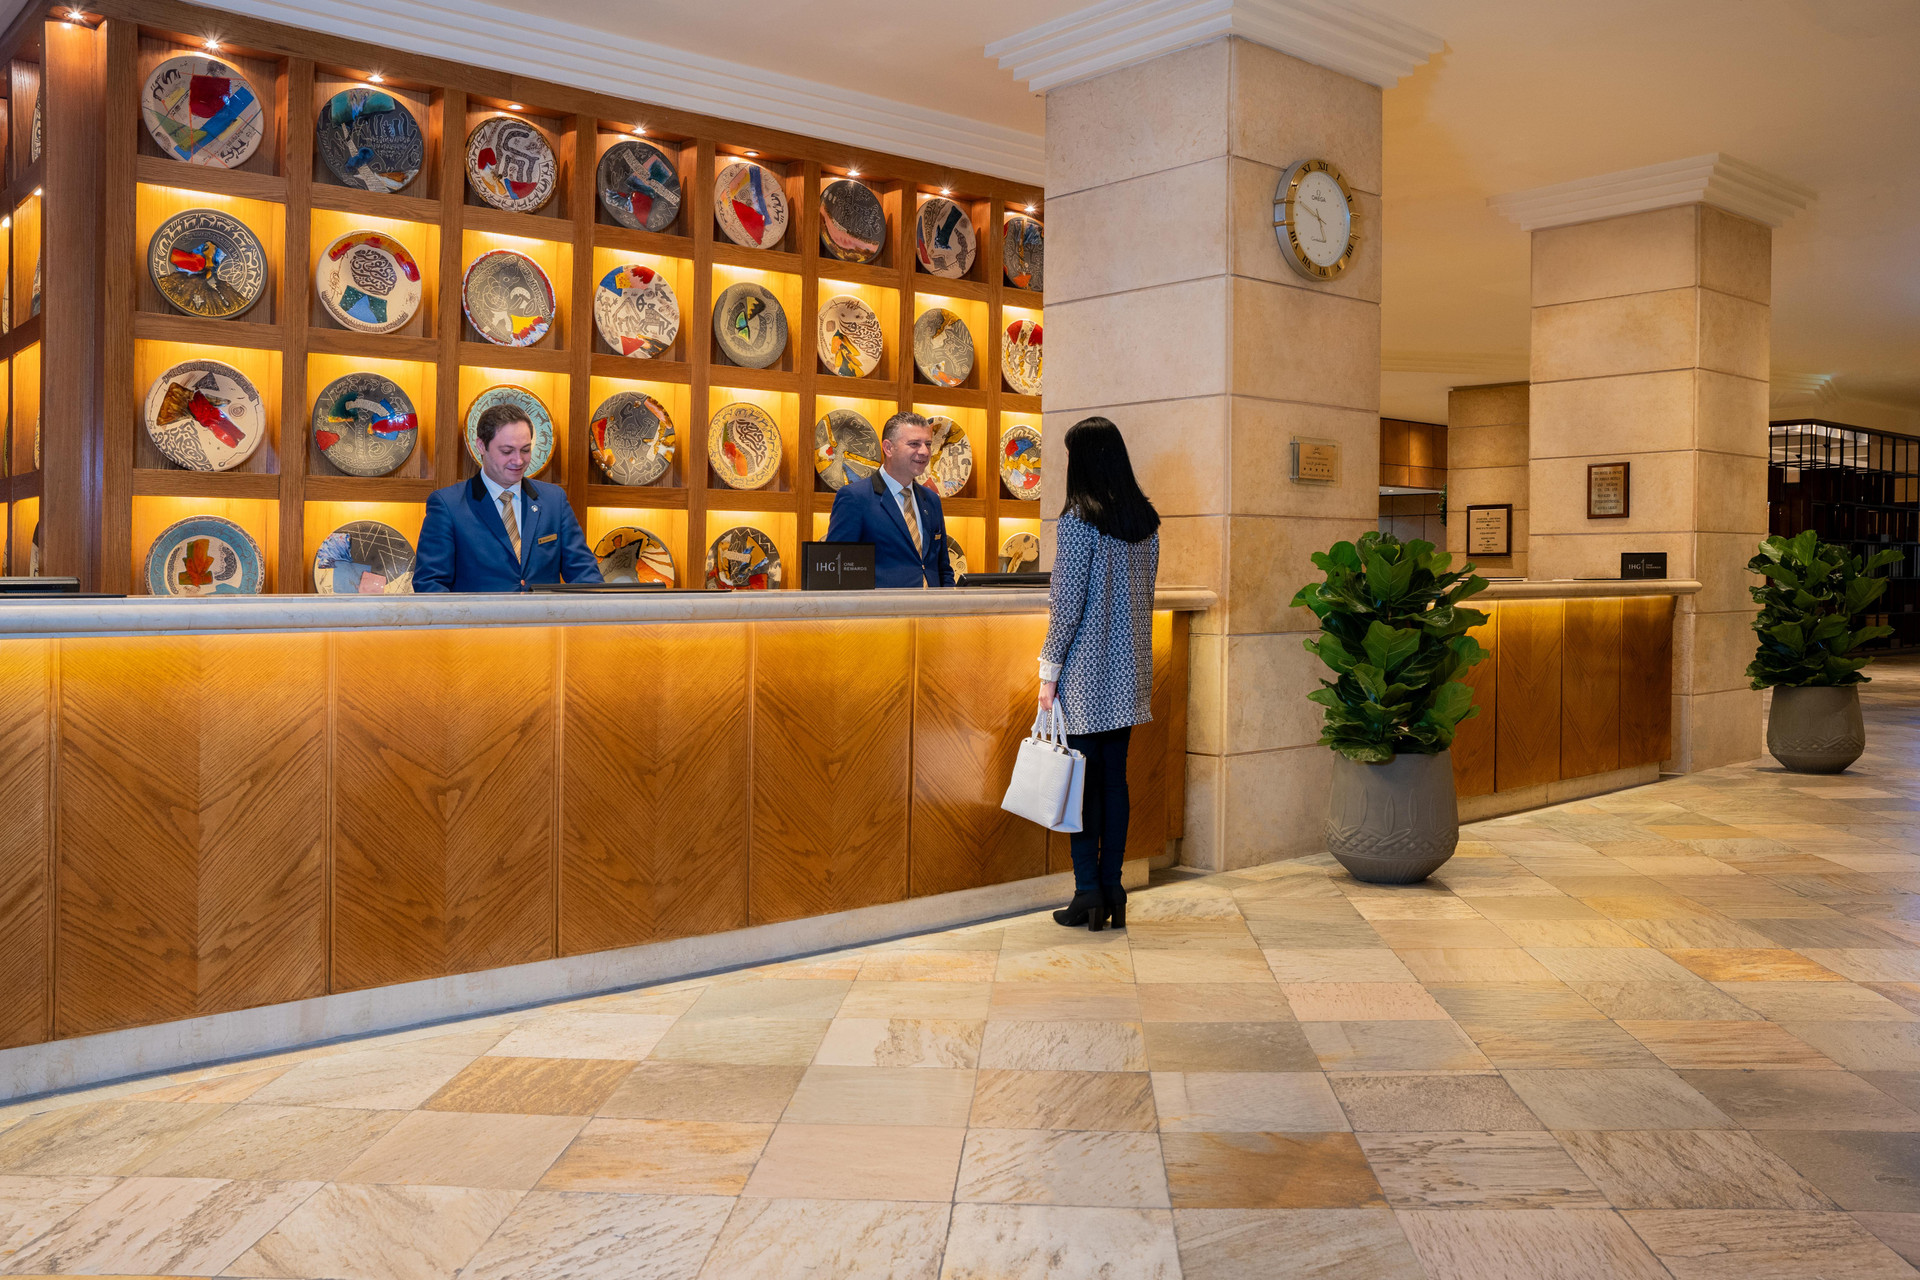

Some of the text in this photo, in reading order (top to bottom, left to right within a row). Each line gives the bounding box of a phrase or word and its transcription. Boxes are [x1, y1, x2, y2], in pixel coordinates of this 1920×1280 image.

[1302, 164, 1312, 175] XI
[1318, 161, 1328, 171] XII
[1346, 194, 1353, 203] II
[1302, 256, 1311, 269] VII
[1318, 266, 1327, 276] VI
[1336, 264, 1342, 273] V
[816, 562, 836, 572] IHG
